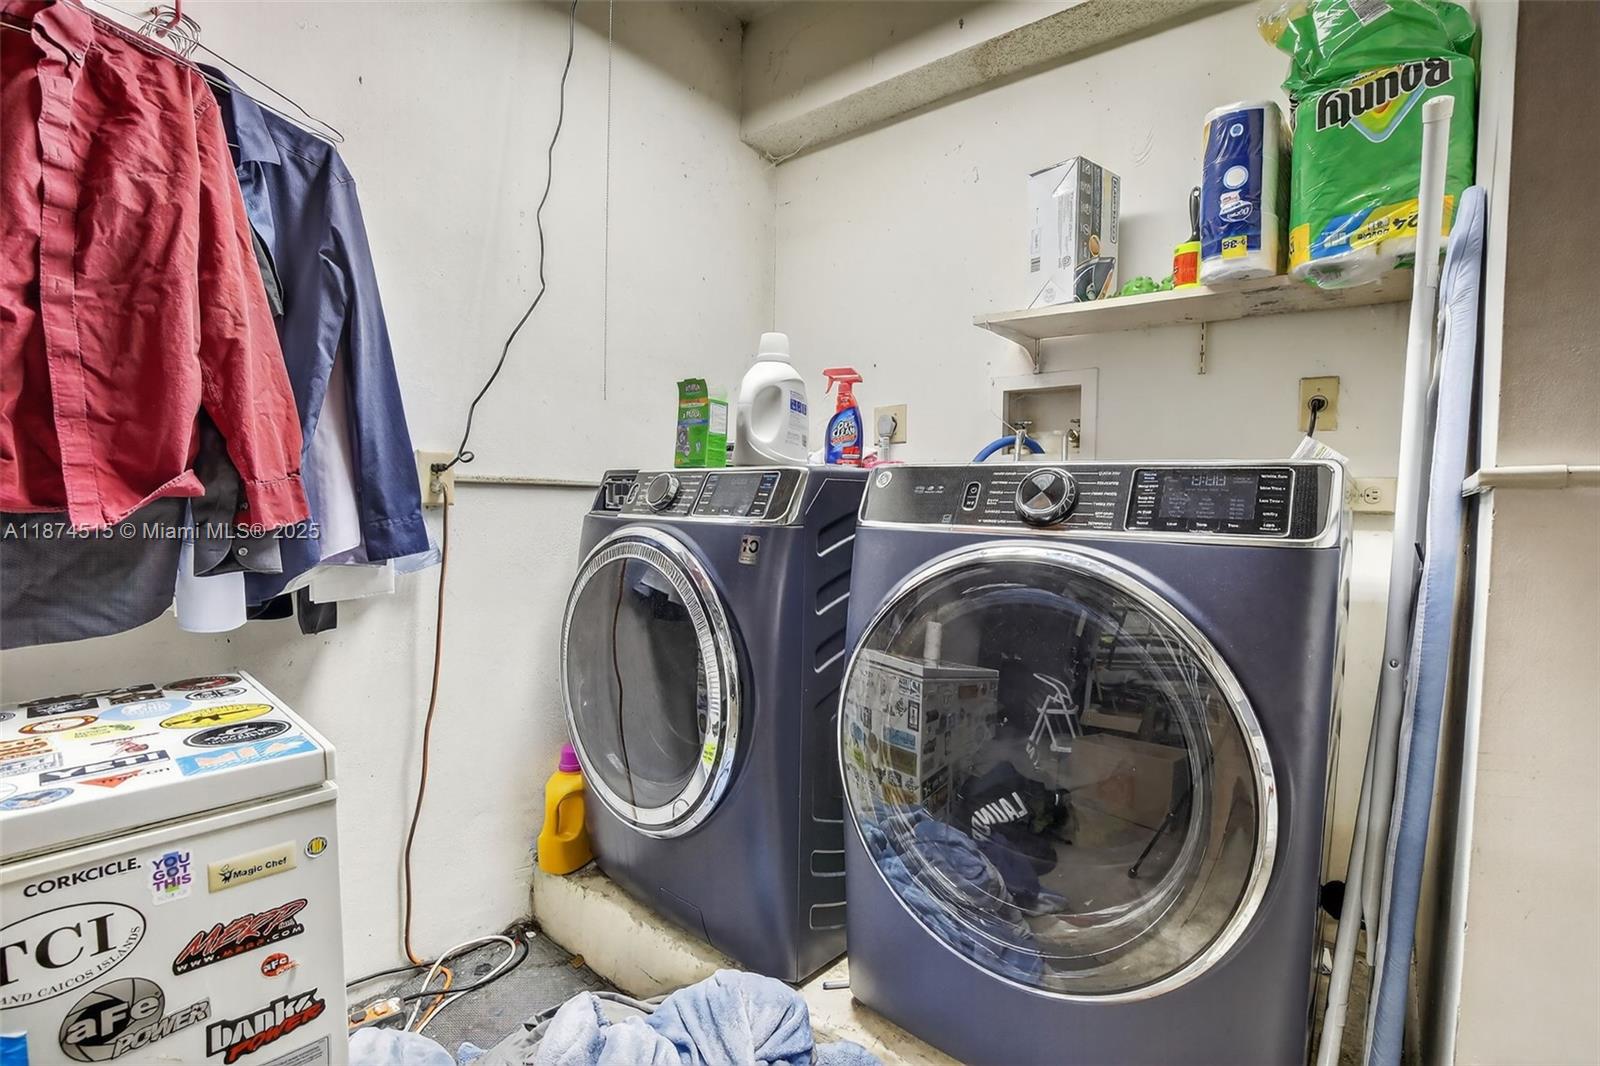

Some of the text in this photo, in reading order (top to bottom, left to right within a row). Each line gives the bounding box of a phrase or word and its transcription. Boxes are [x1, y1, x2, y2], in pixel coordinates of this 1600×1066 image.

[1316, 58, 1453, 131] Bounty
[45, 751, 160, 779] YETI
[152, 852, 190, 870] YOU
[152, 862, 191, 882] GOT
[232, 856, 287, 879] Magic Chef
[152, 873, 192, 892] THIS
[37, 968, 95, 999] CAICOS
[96, 925, 141, 972] ISLANDS
[65, 997, 161, 1045] aFe
[110, 1001, 210, 1060] POWER
